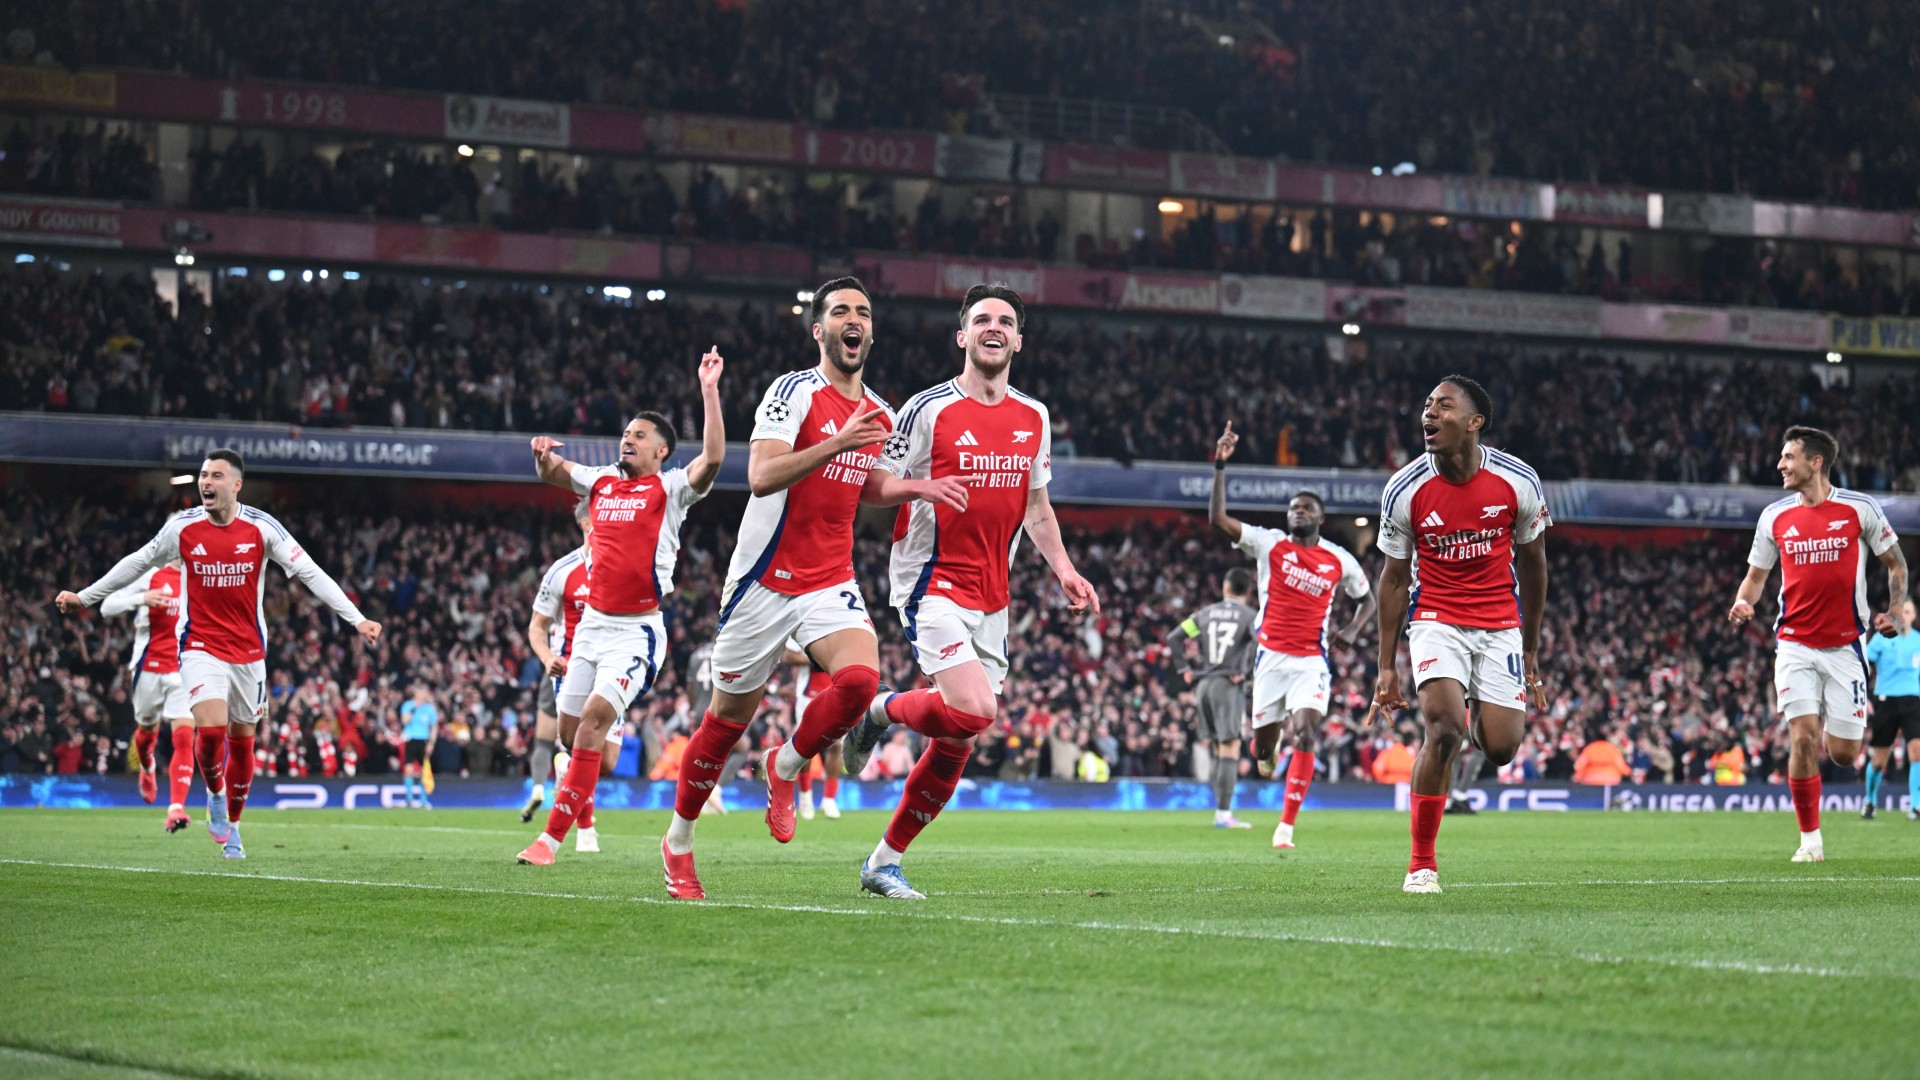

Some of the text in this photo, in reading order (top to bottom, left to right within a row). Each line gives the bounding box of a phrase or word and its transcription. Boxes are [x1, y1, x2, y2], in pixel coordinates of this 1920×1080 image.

[263, 92, 346, 125] 1998
[486, 103, 560, 129] Arsenal
[840, 136, 915, 169] 2002
[38, 210, 120, 234] GOONERS
[1121, 275, 1216, 310] Arsenal
[165, 434, 434, 465] UEFA CHAMPIONS LEAGUE
[958, 451, 1032, 470] Emirates
[822, 464, 868, 486] FLY BETTER
[970, 472, 1023, 488] FLY BETTER
[1179, 477, 1214, 498] UEF
[595, 496, 647, 510] Emirates
[597, 510, 636, 521] FLY BETTER
[1424, 527, 1504, 548] Emirates
[1784, 536, 1849, 555] Emirates
[1438, 539, 1492, 560] FLY BETTER
[1795, 550, 1840, 565] FLY BETTER
[193, 561, 254, 575] Emirates
[1281, 559, 1332, 590] Emirates
[203, 574, 246, 588] FLY BETTER
[840, 590, 864, 612] 2
[1207, 620, 1239, 665] 17
[626, 655, 641, 681] 2
[696, 659, 712, 691] 4
[1318, 672, 1327, 691] 5
[693, 758, 723, 770] AFC
[561, 785, 579, 800] AFC
[1648, 794, 1716, 812] UEFA
